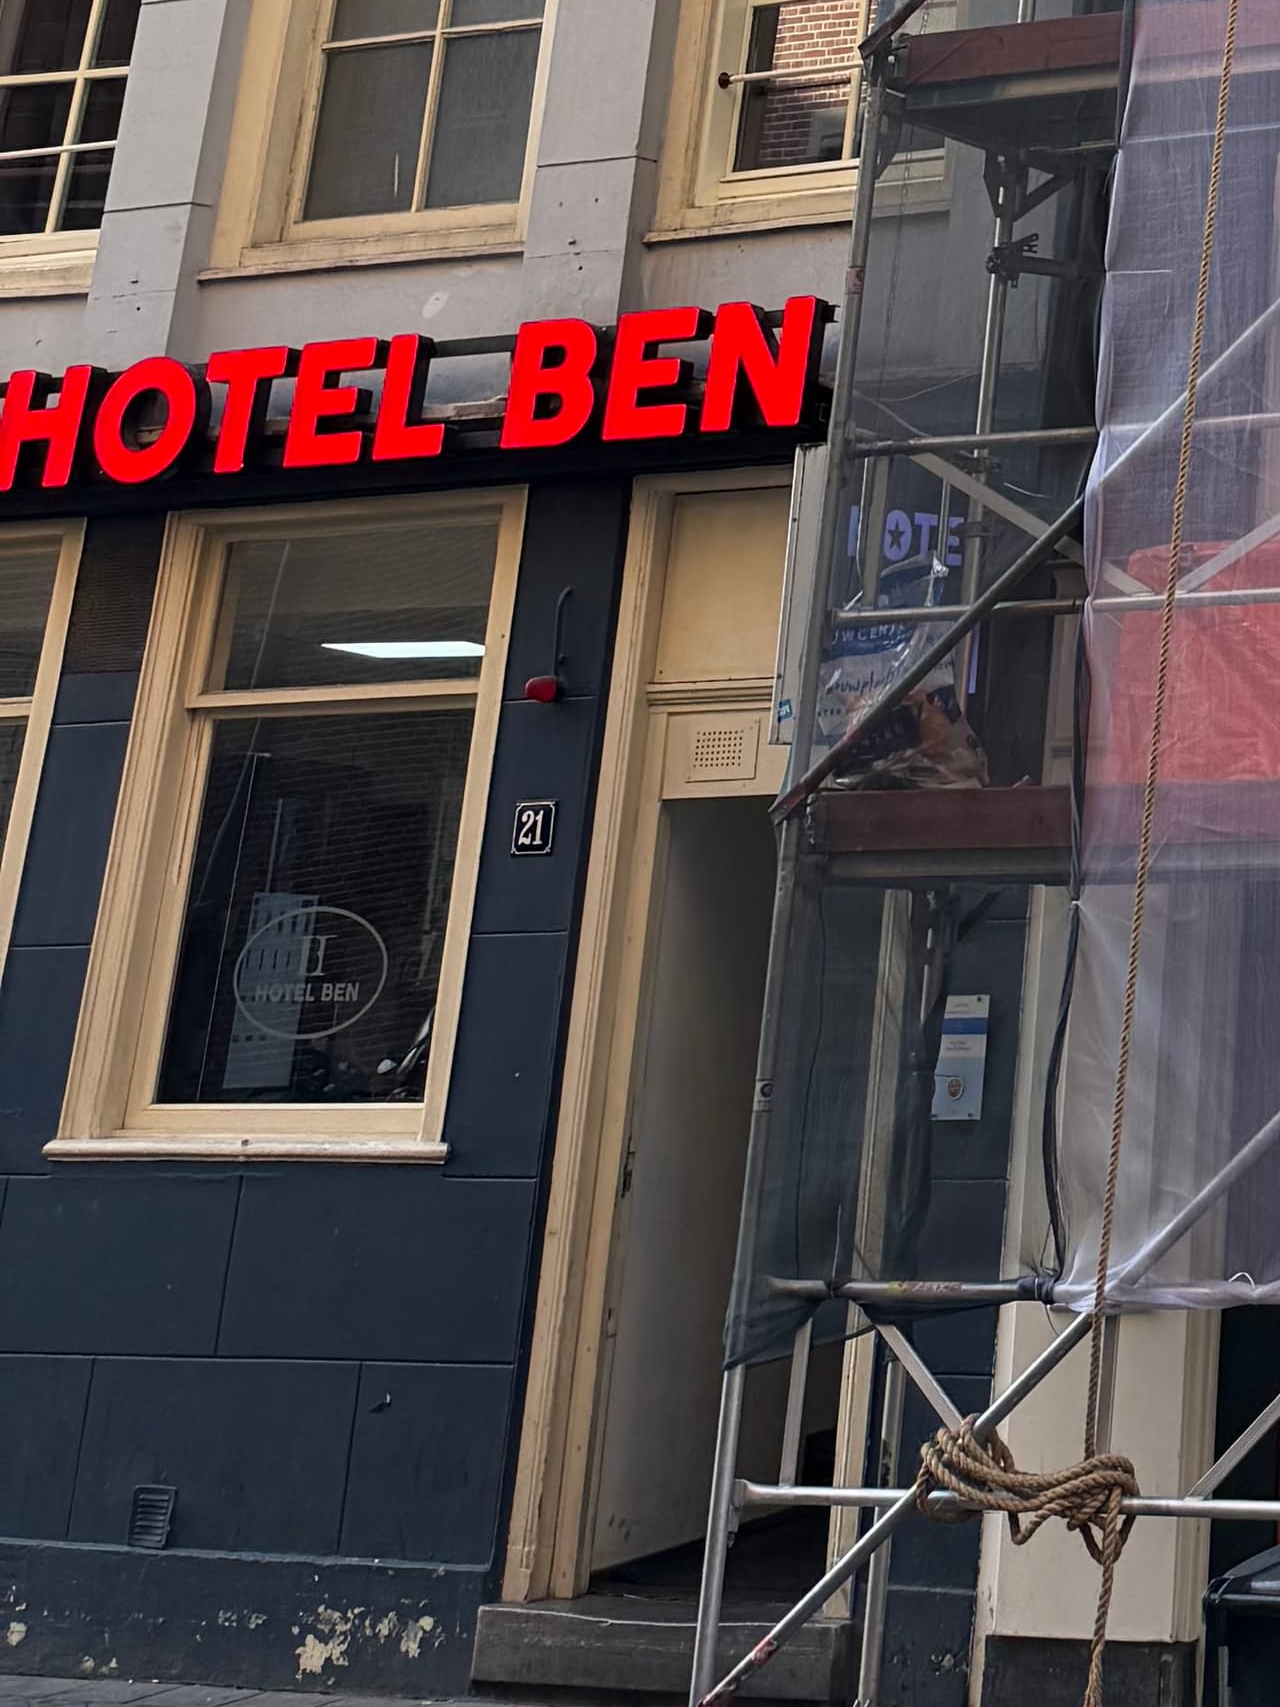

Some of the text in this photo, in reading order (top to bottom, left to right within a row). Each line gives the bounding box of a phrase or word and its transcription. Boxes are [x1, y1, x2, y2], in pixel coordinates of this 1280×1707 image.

[0, 296, 816, 491] HOTEL BEN
[518, 809, 544, 846] 21
[254, 982, 361, 1002] HOTEL BEN
